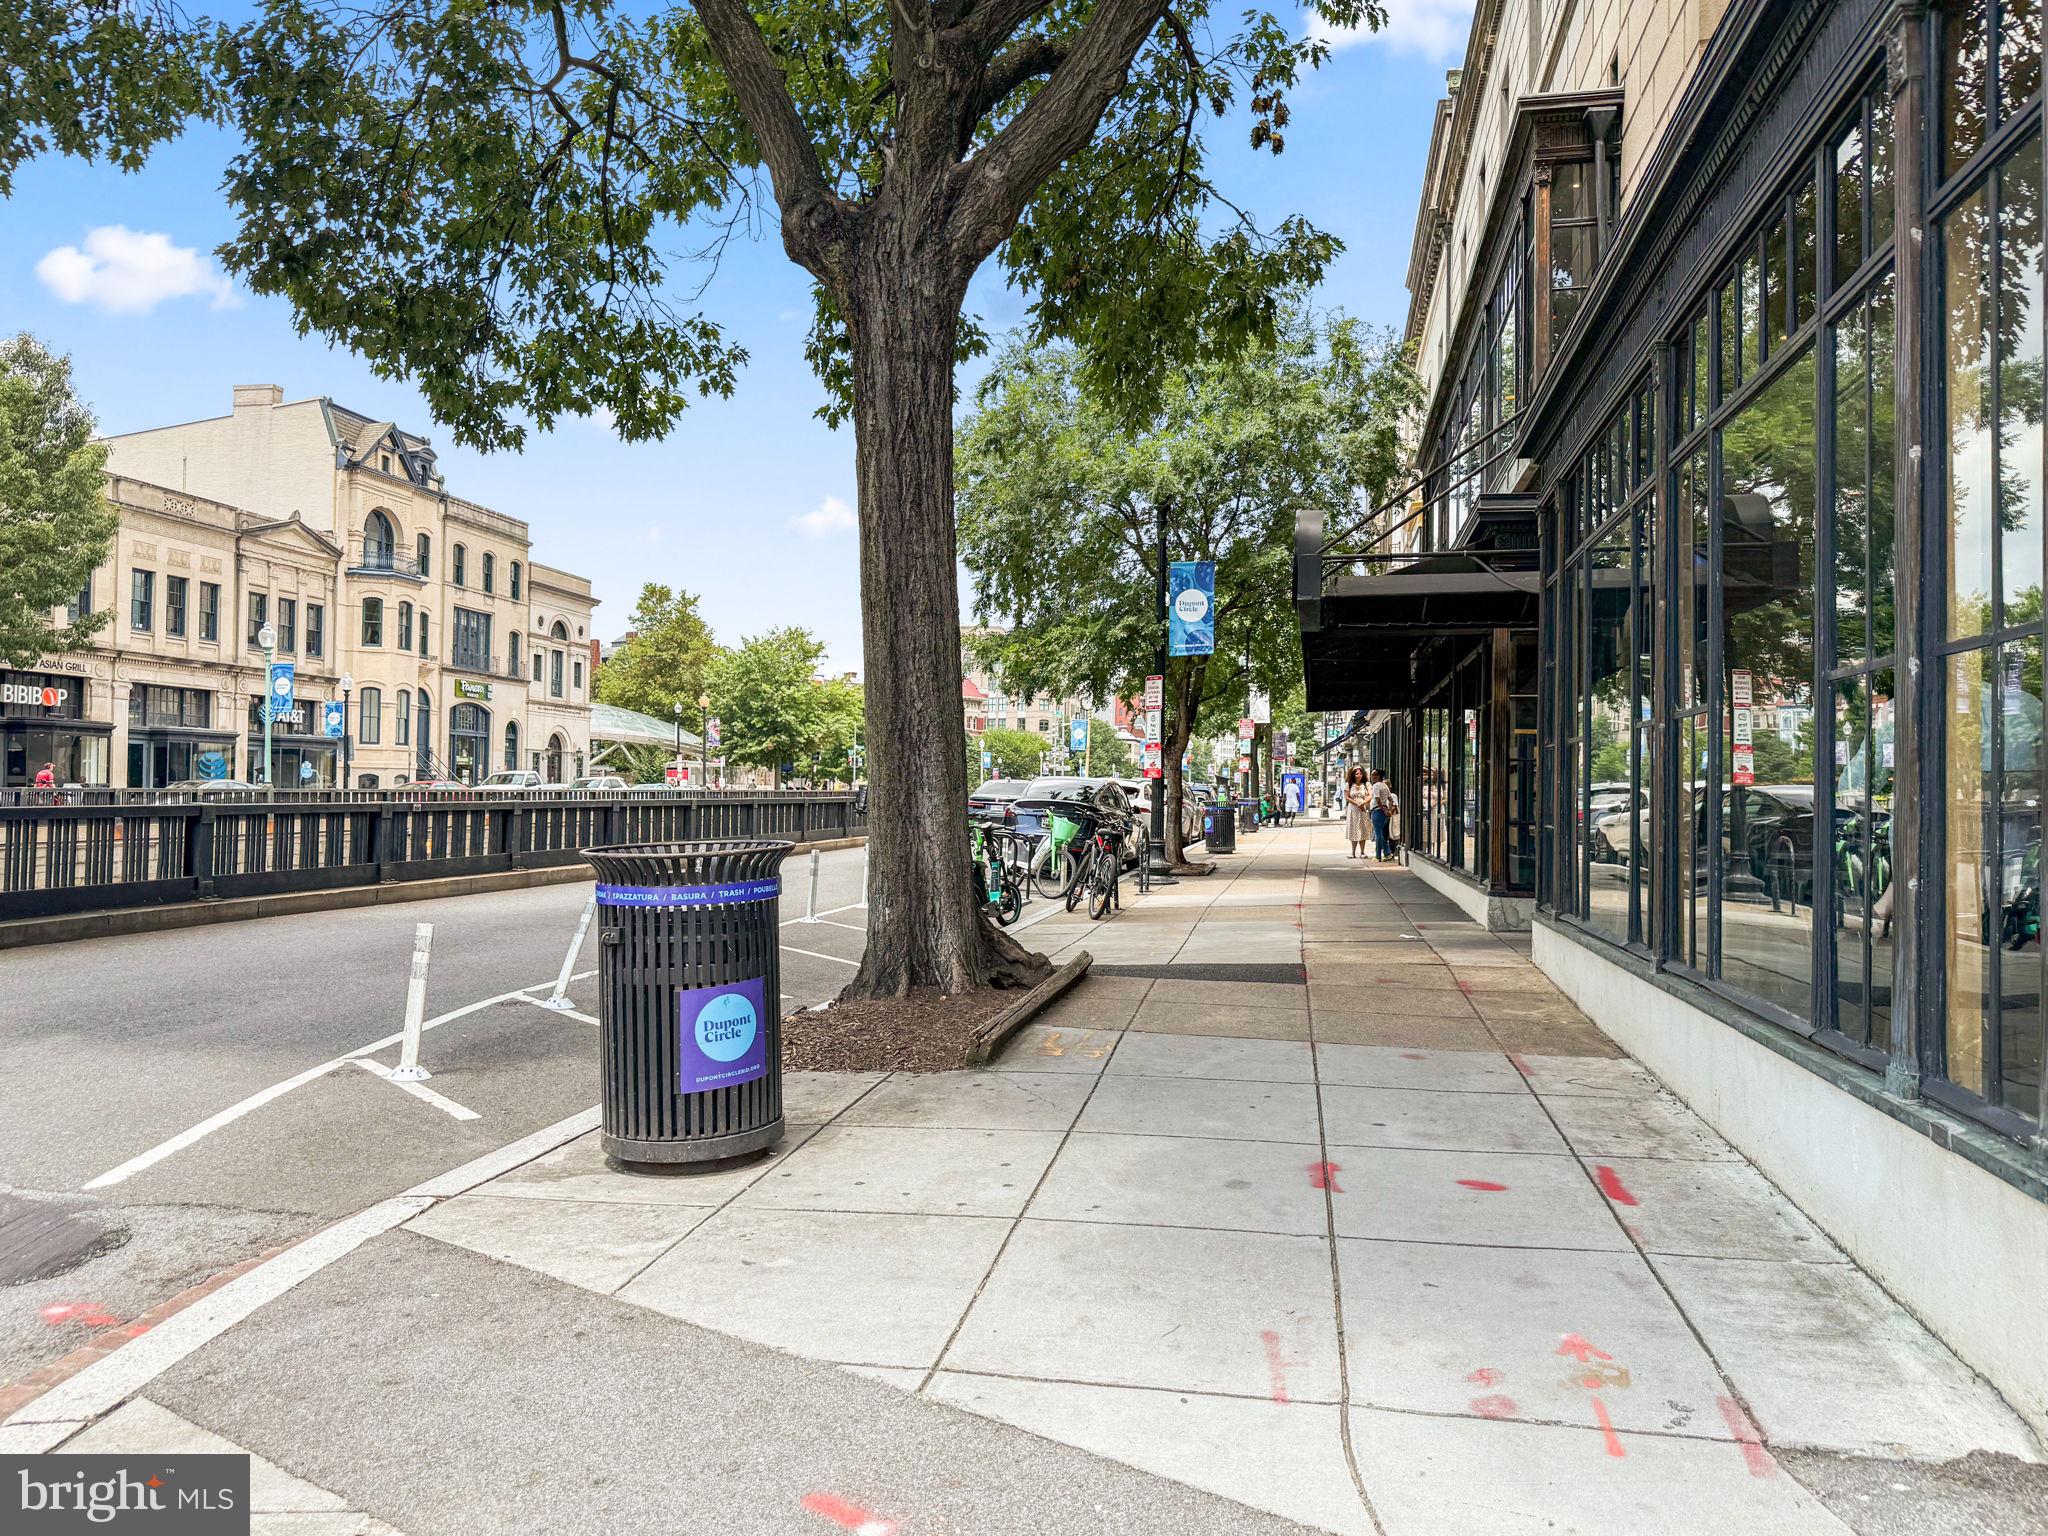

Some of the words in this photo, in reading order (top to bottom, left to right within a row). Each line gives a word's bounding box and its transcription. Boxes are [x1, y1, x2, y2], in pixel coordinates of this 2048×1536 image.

[1179, 600, 1205, 608] Dupont
[39, 659, 63, 670] ASIAN
[65, 662, 87, 672] GRILL
[1, 683, 68, 707] BIBIBOP
[277, 709, 306, 723] AT&T
[612, 892, 659, 900] SPAZZATURA
[719, 888, 745, 898] TRASH
[703, 1014, 752, 1032] Dupont
[704, 1027, 742, 1044] Circle
[695, 1063, 761, 1083] DUPONTCIRCLEBID.ORG
